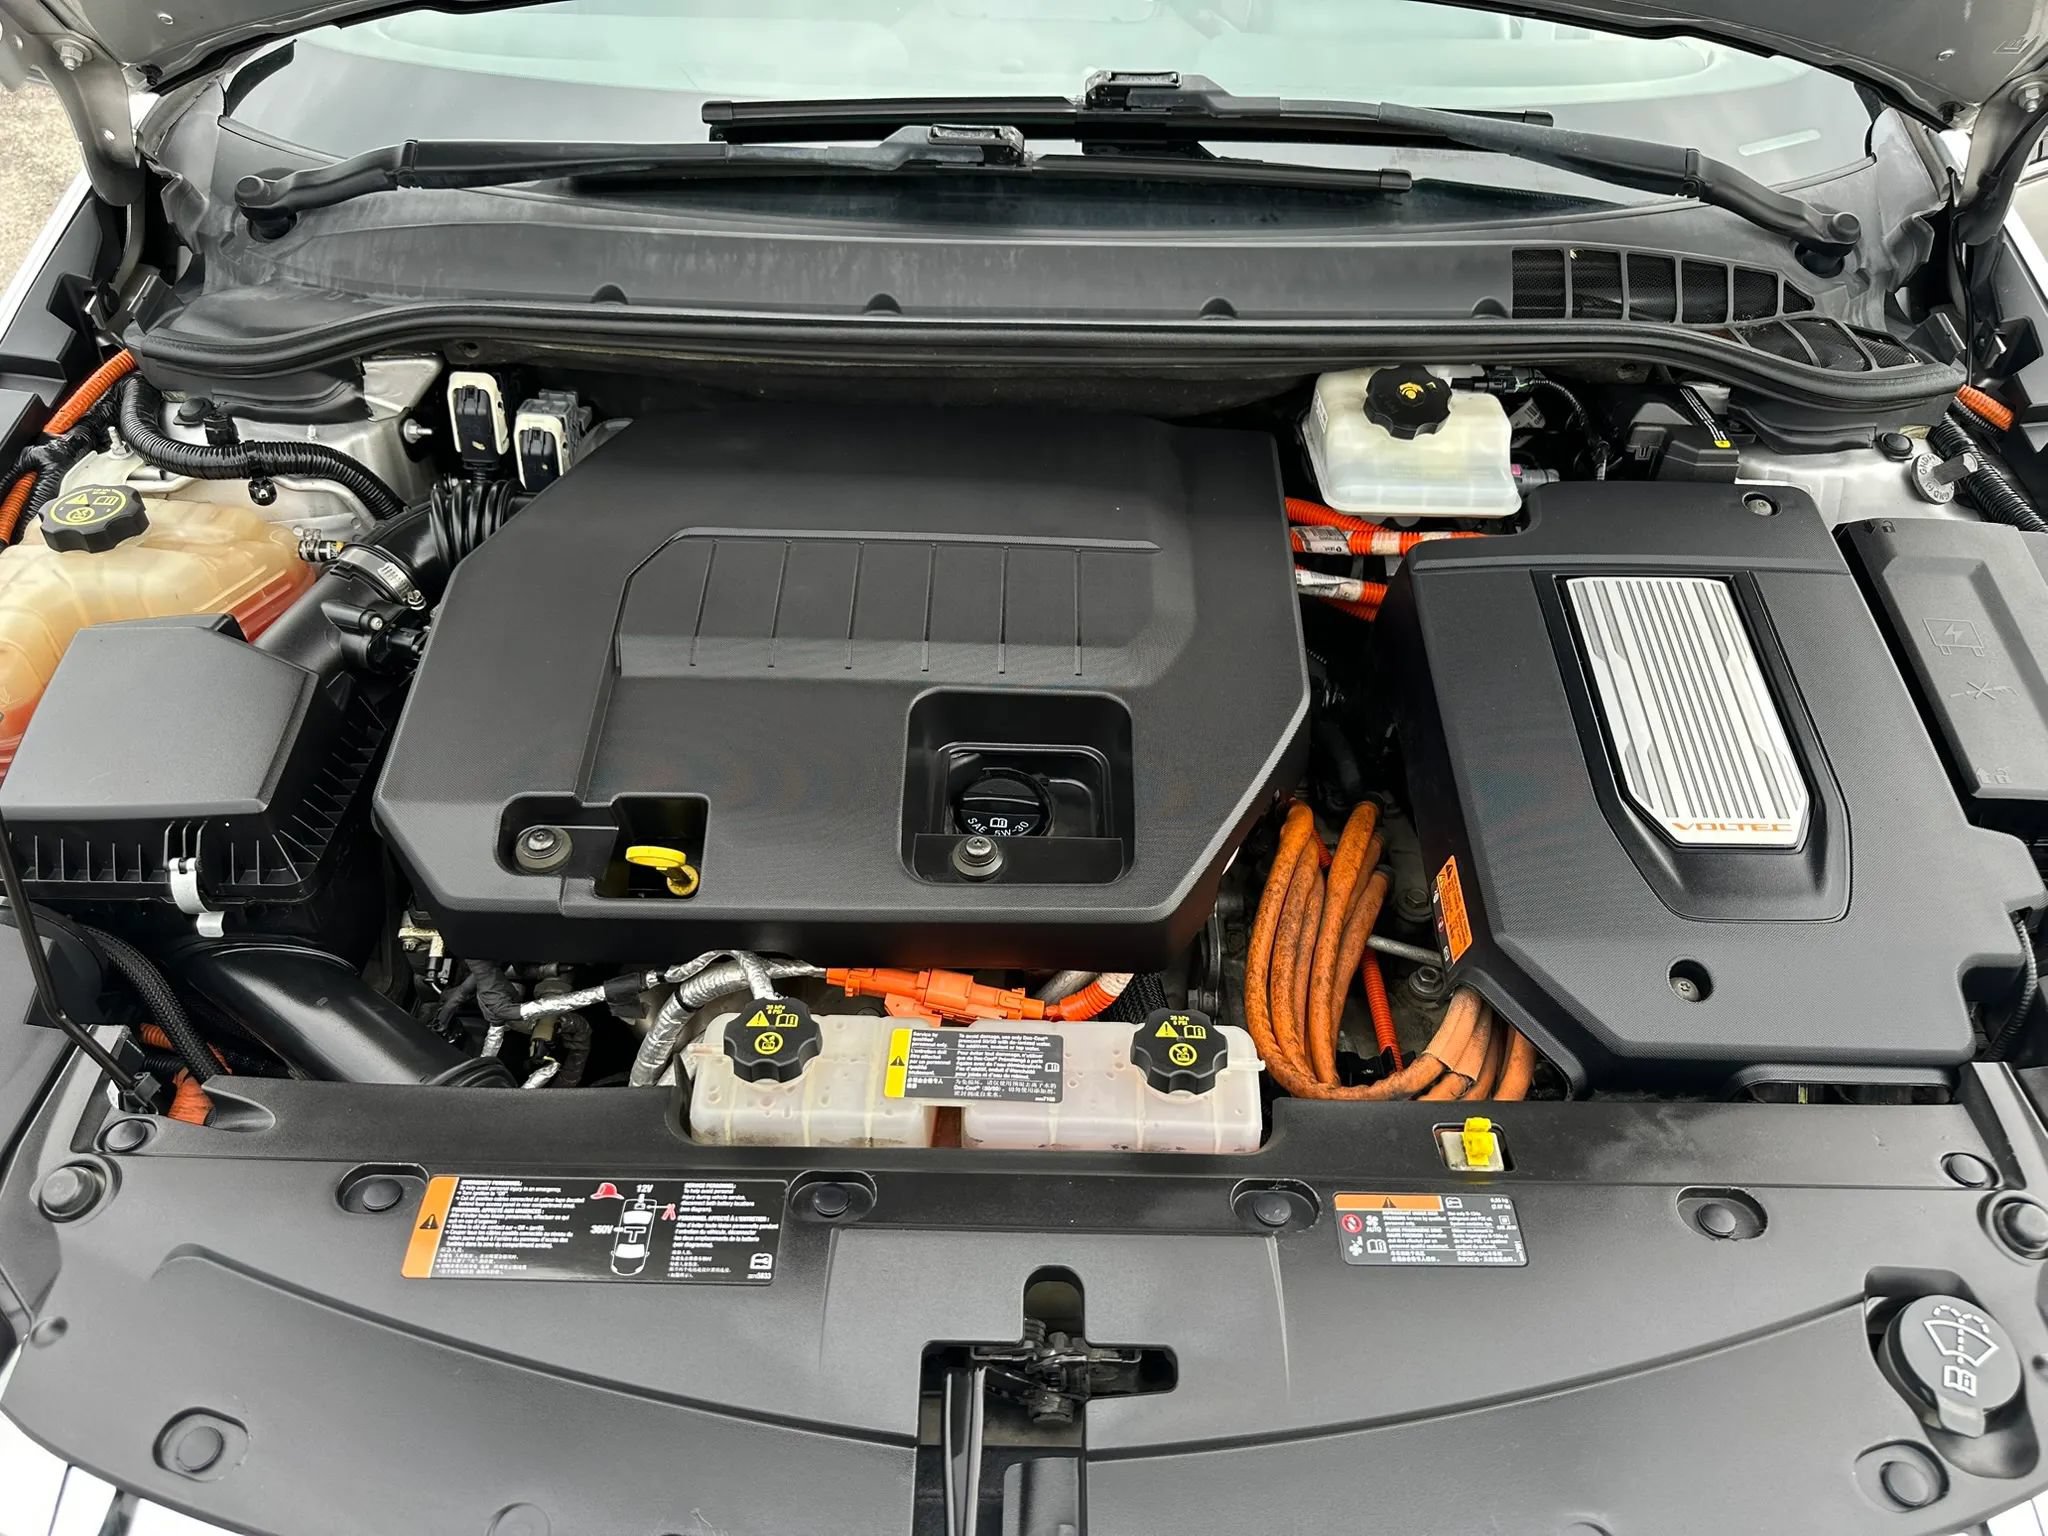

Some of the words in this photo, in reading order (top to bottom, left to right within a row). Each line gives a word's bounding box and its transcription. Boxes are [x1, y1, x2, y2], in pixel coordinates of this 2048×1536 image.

[968, 817, 988, 834] SAE
[1672, 822, 1792, 832] VOLTEC
[636, 1184, 653, 1193] 12V
